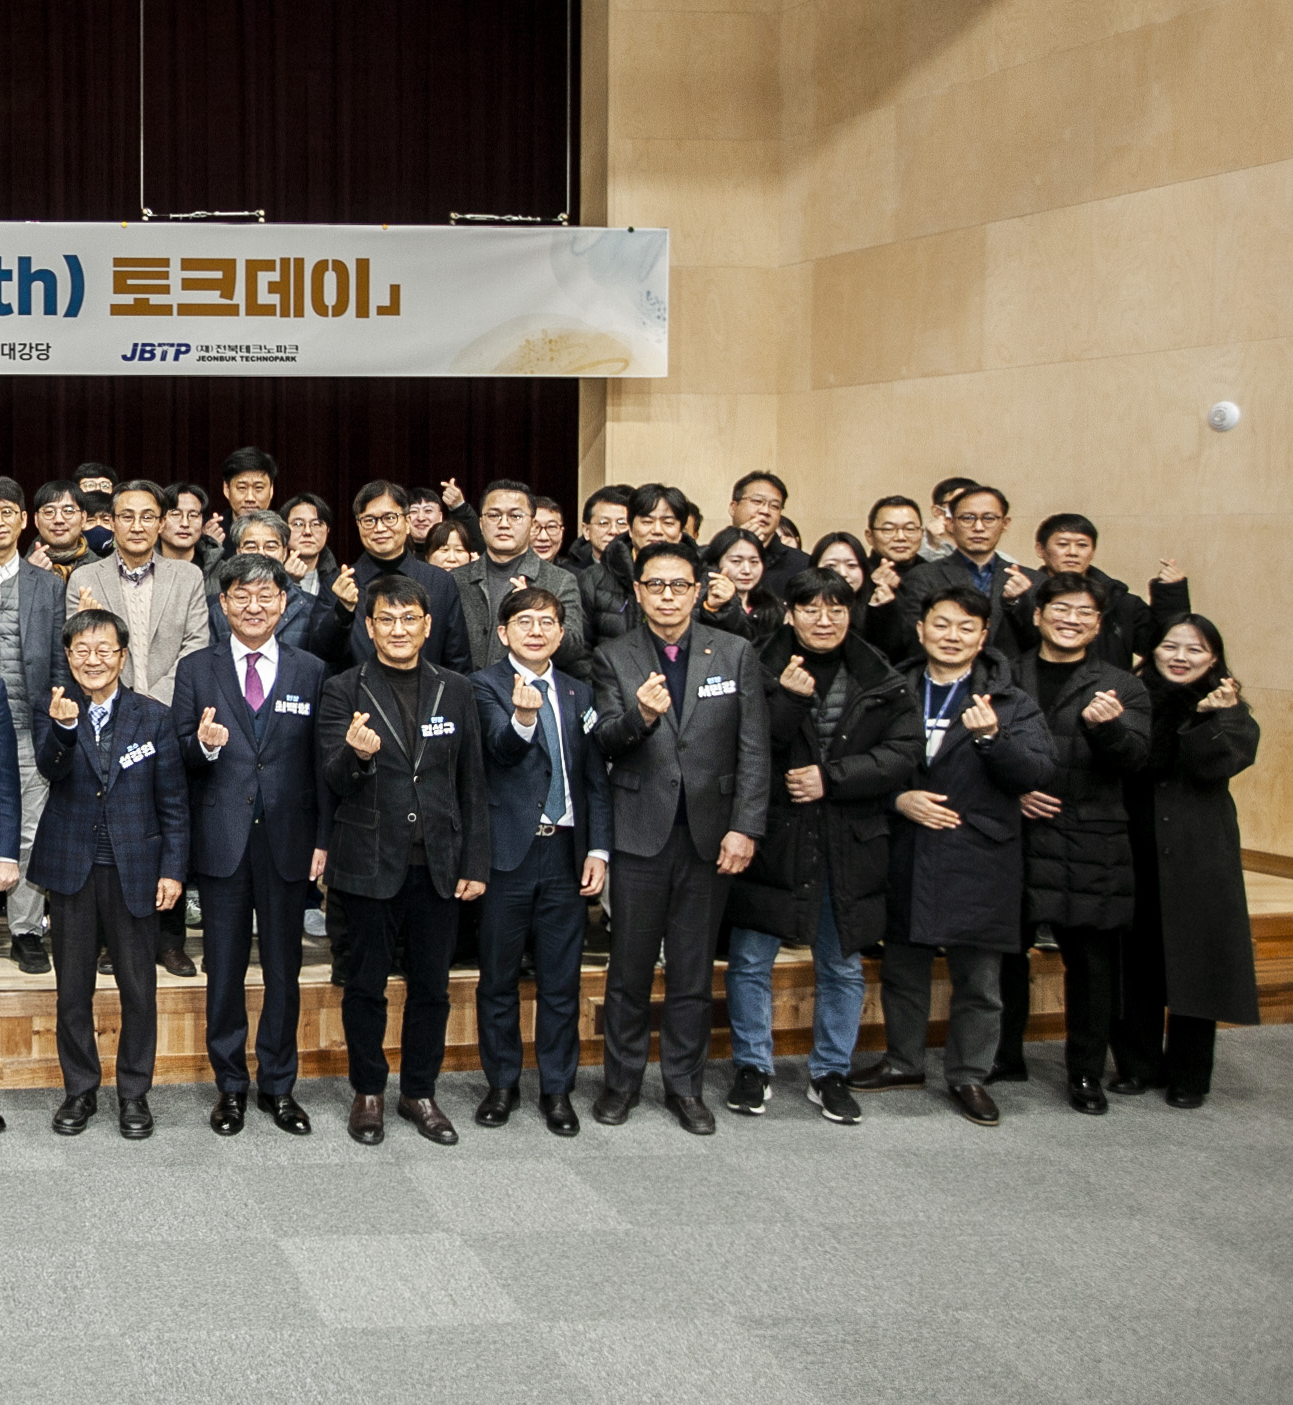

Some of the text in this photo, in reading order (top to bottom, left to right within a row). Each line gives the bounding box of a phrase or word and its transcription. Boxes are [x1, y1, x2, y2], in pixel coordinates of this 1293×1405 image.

[110, 256, 401, 318] 토크데이」
[0, 342, 52, 361] 대강당
[121, 343, 192, 362] JBTP
[196, 355, 298, 363] JEONBUK TECHNOPARK
[420, 722, 455, 738] 김성규
